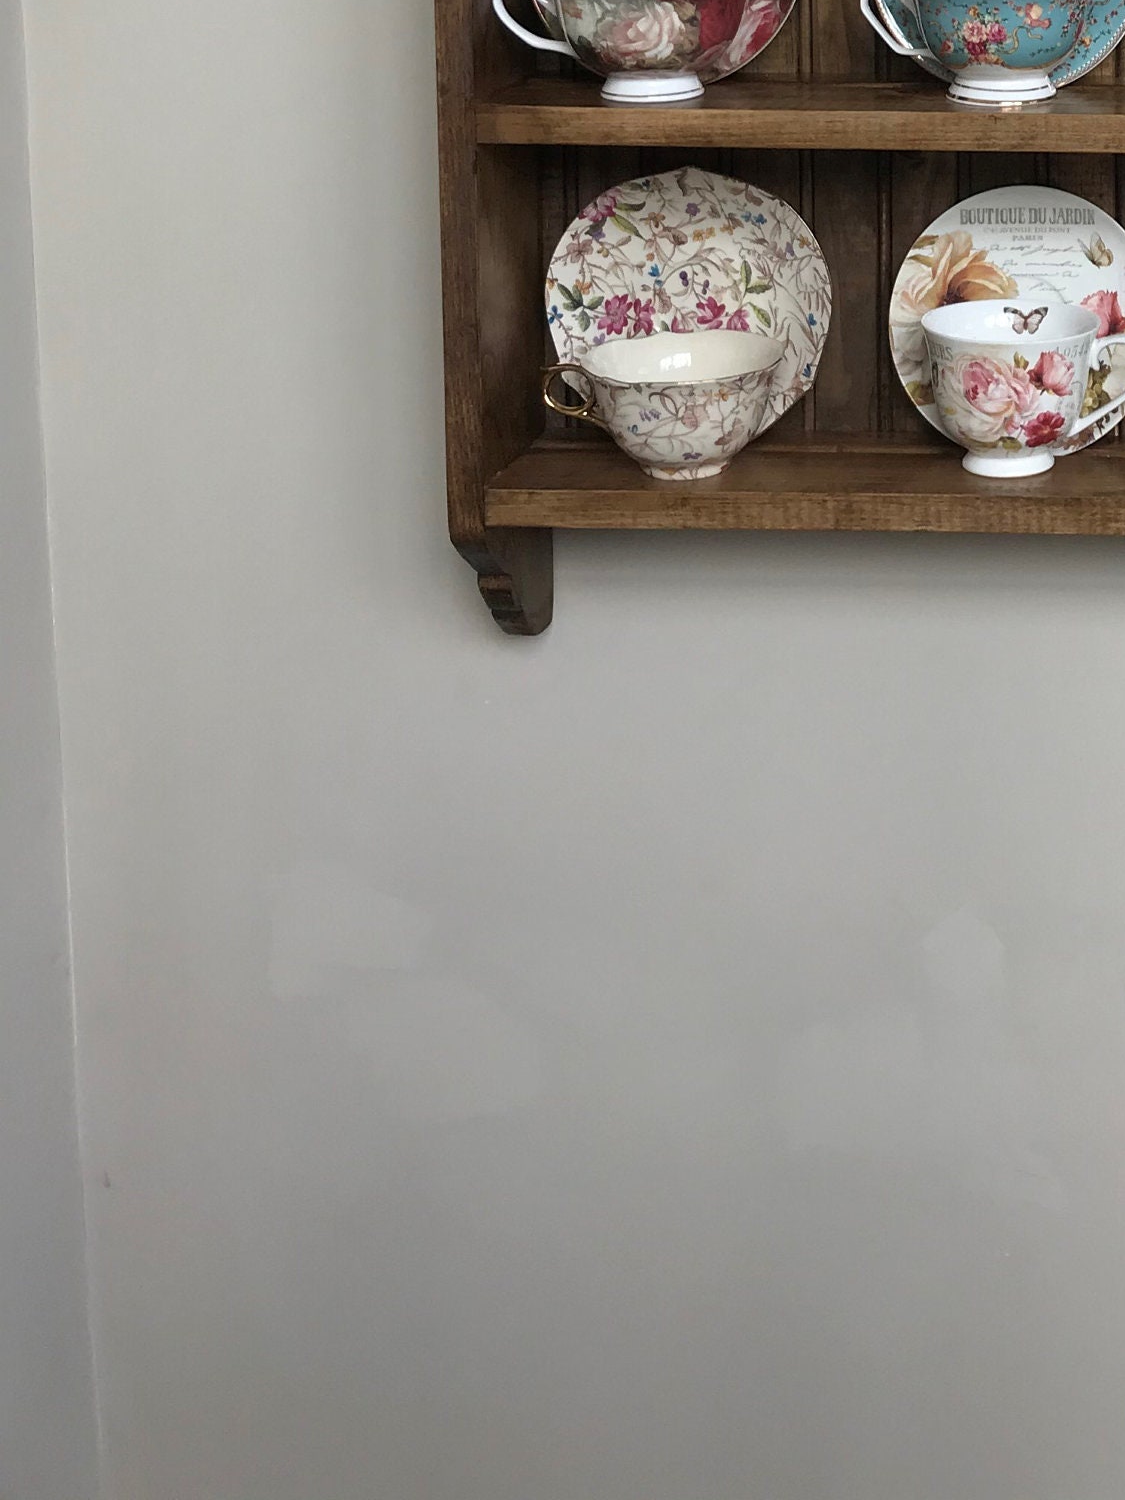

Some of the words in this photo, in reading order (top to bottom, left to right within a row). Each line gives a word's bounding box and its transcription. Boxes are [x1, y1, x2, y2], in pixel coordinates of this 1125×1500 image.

[959, 207, 1026, 225] BOUTIQUE
[1028, 207, 1047, 225] DU
[1049, 207, 1096, 225] JARDIN
